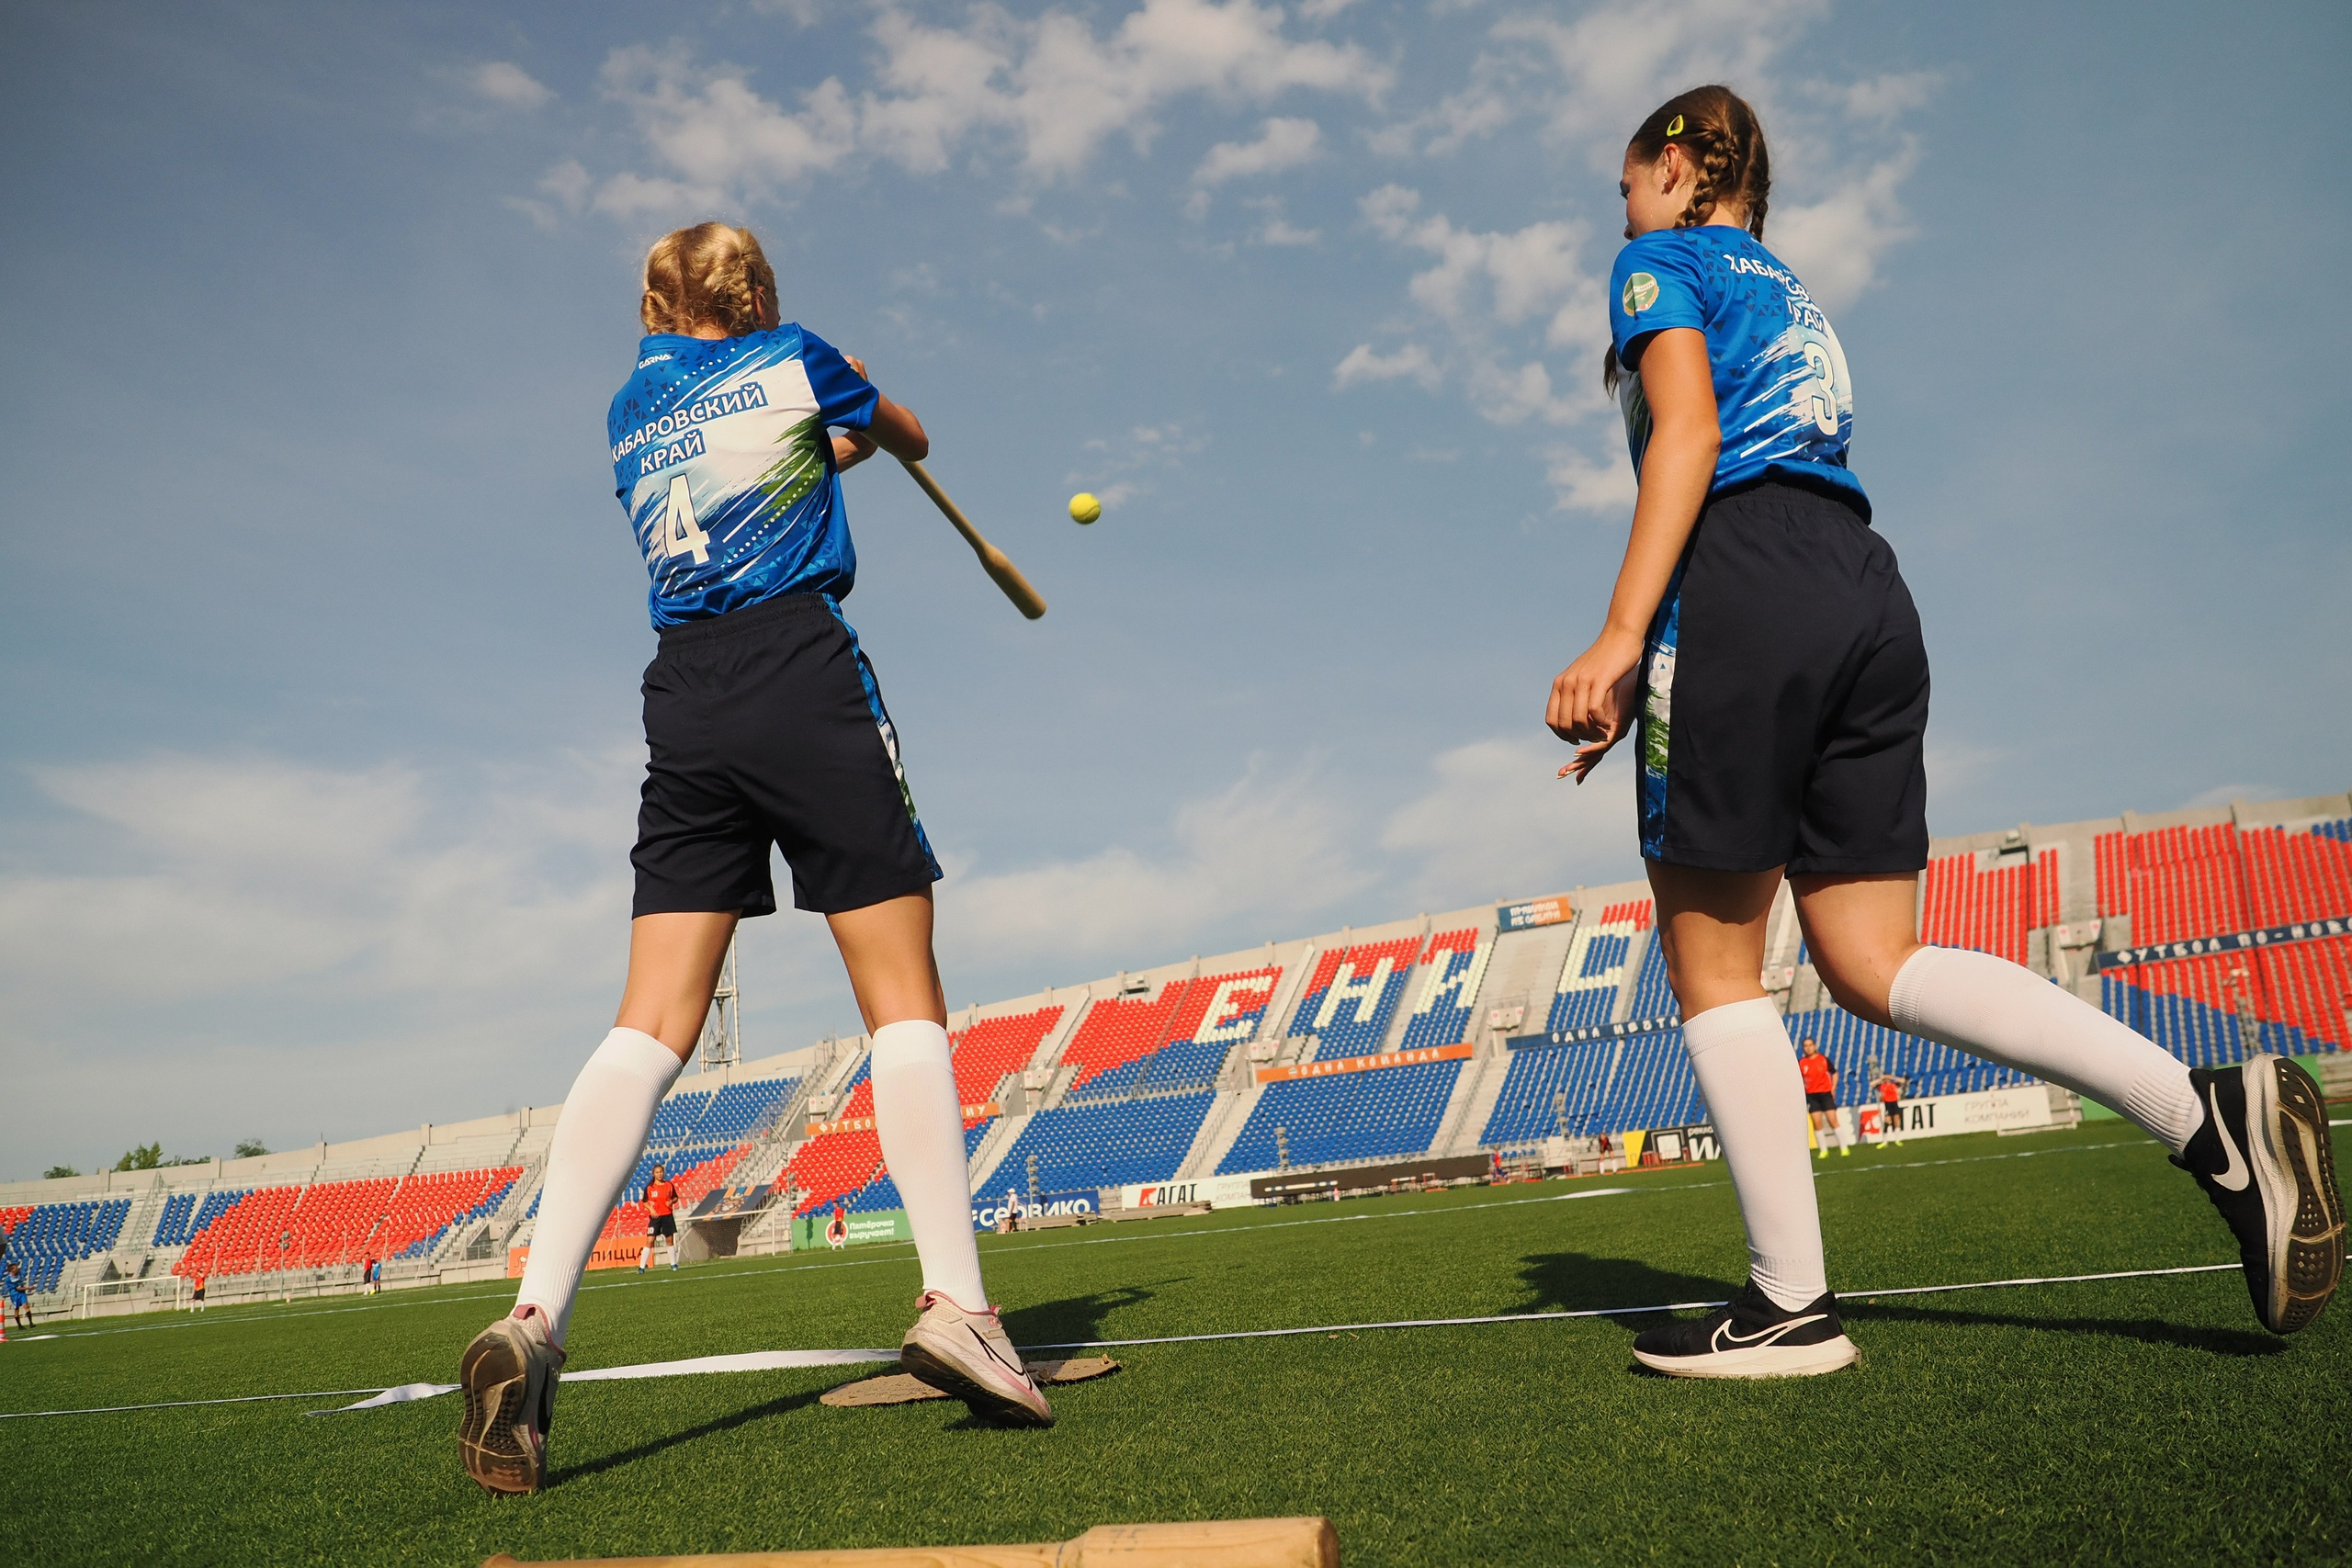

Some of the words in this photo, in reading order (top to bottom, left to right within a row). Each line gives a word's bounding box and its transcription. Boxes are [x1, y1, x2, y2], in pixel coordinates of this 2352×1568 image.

[1804, 341, 1838, 436] 3
[611, 383, 767, 466] ХАБАРОВСКИЙ
[640, 431, 704, 475] КРАЙ
[664, 474, 710, 565] 4
[819, 1118, 876, 1133] ФУТБО
[1158, 1183, 1197, 1205] АГАТ
[647, 1226, 654, 1235] 10
